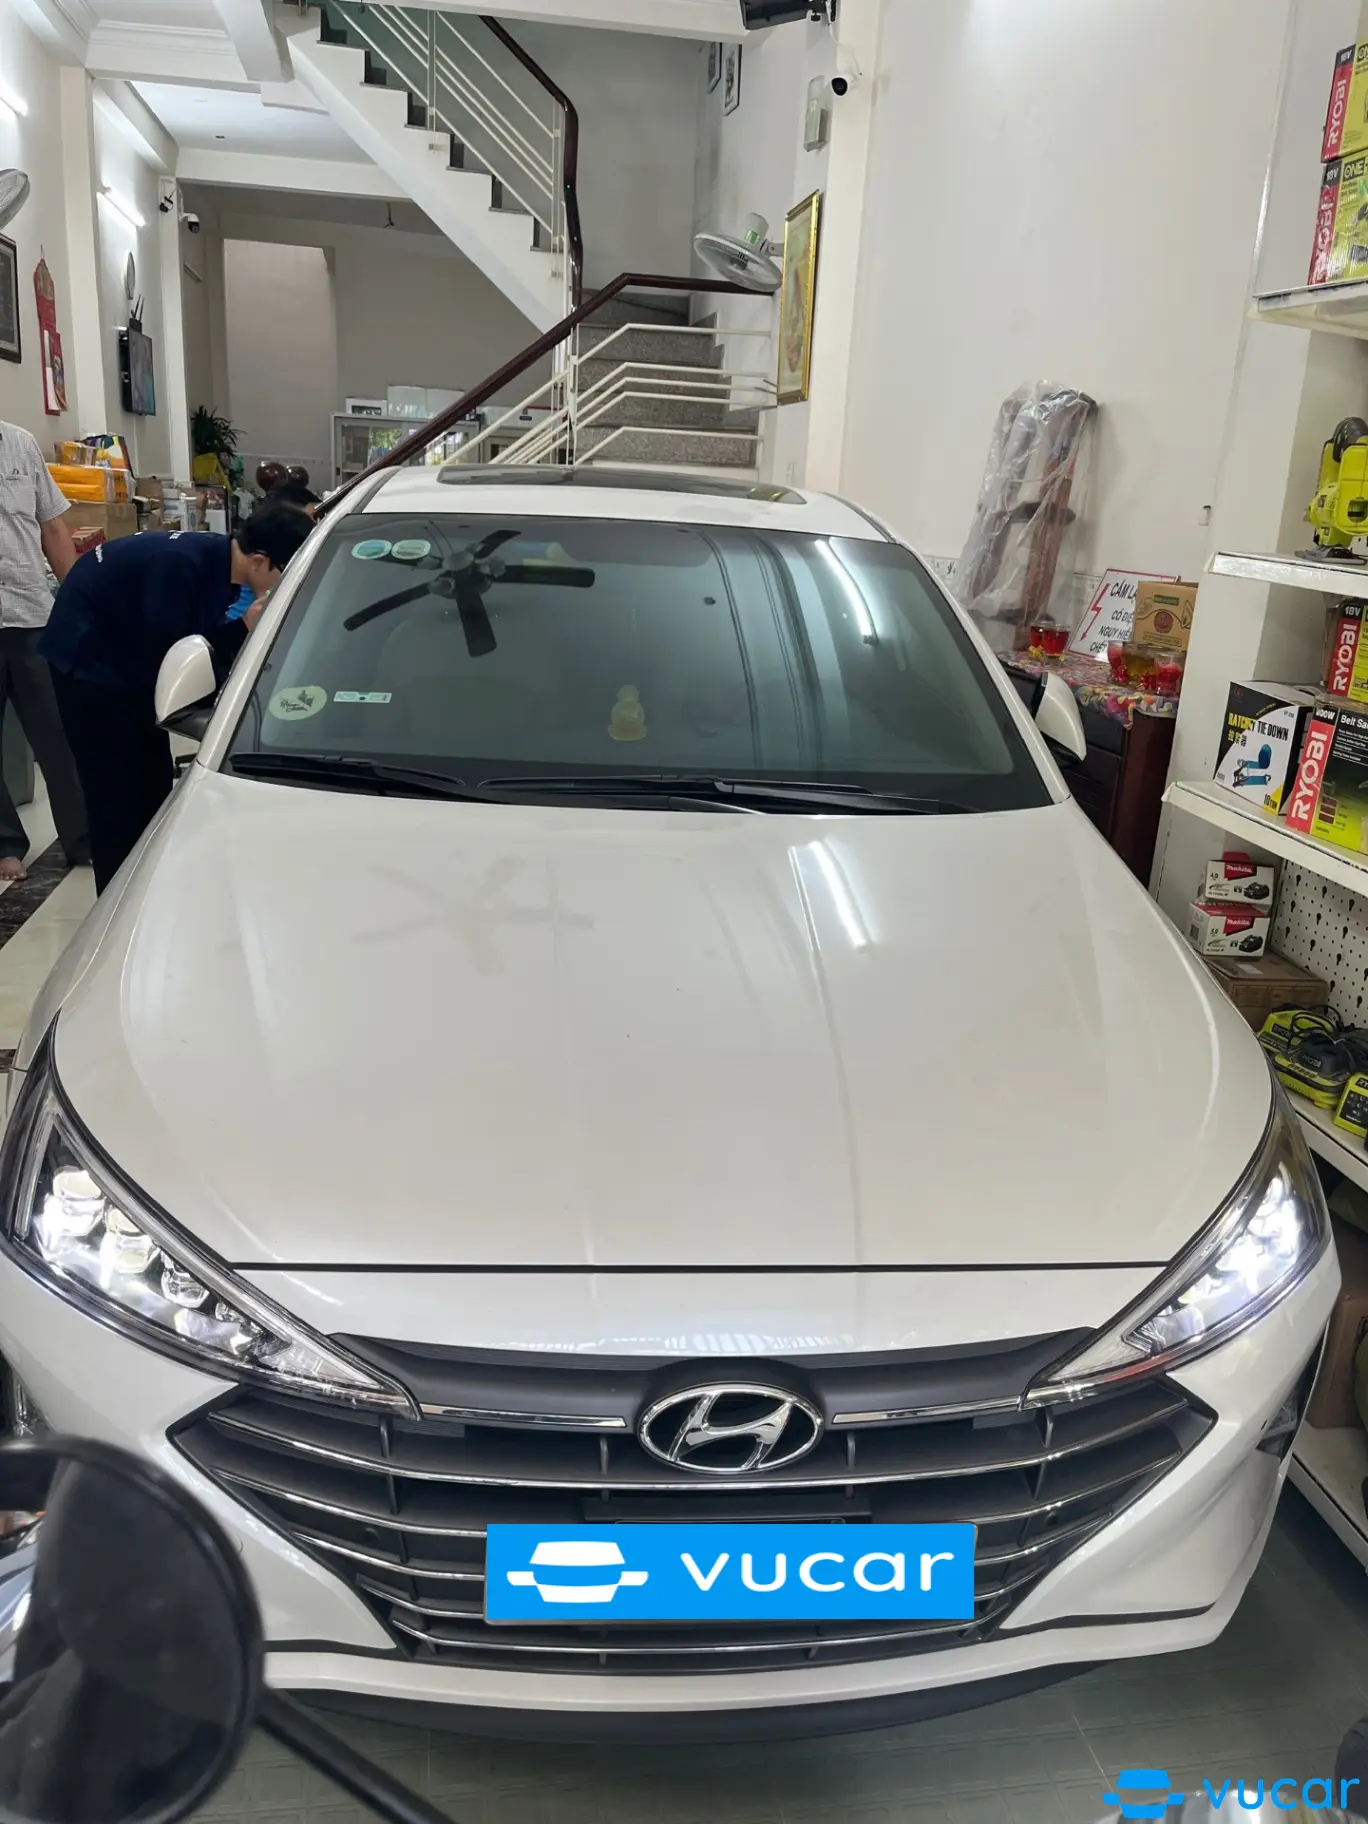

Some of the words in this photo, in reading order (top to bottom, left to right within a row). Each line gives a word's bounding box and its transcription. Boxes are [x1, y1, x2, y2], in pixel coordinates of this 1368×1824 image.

[1327, 79, 1347, 148] RYOBI
[1326, 167, 1339, 180] 18V
[1345, 606, 1361, 616] 18V
[1333, 624, 1357, 691] RYOBI
[1257, 720, 1268, 736] TIE
[1267, 724, 1290, 741] DOWN
[1340, 714, 1356, 726] Belt
[1291, 731, 1328, 820] RYOBI
